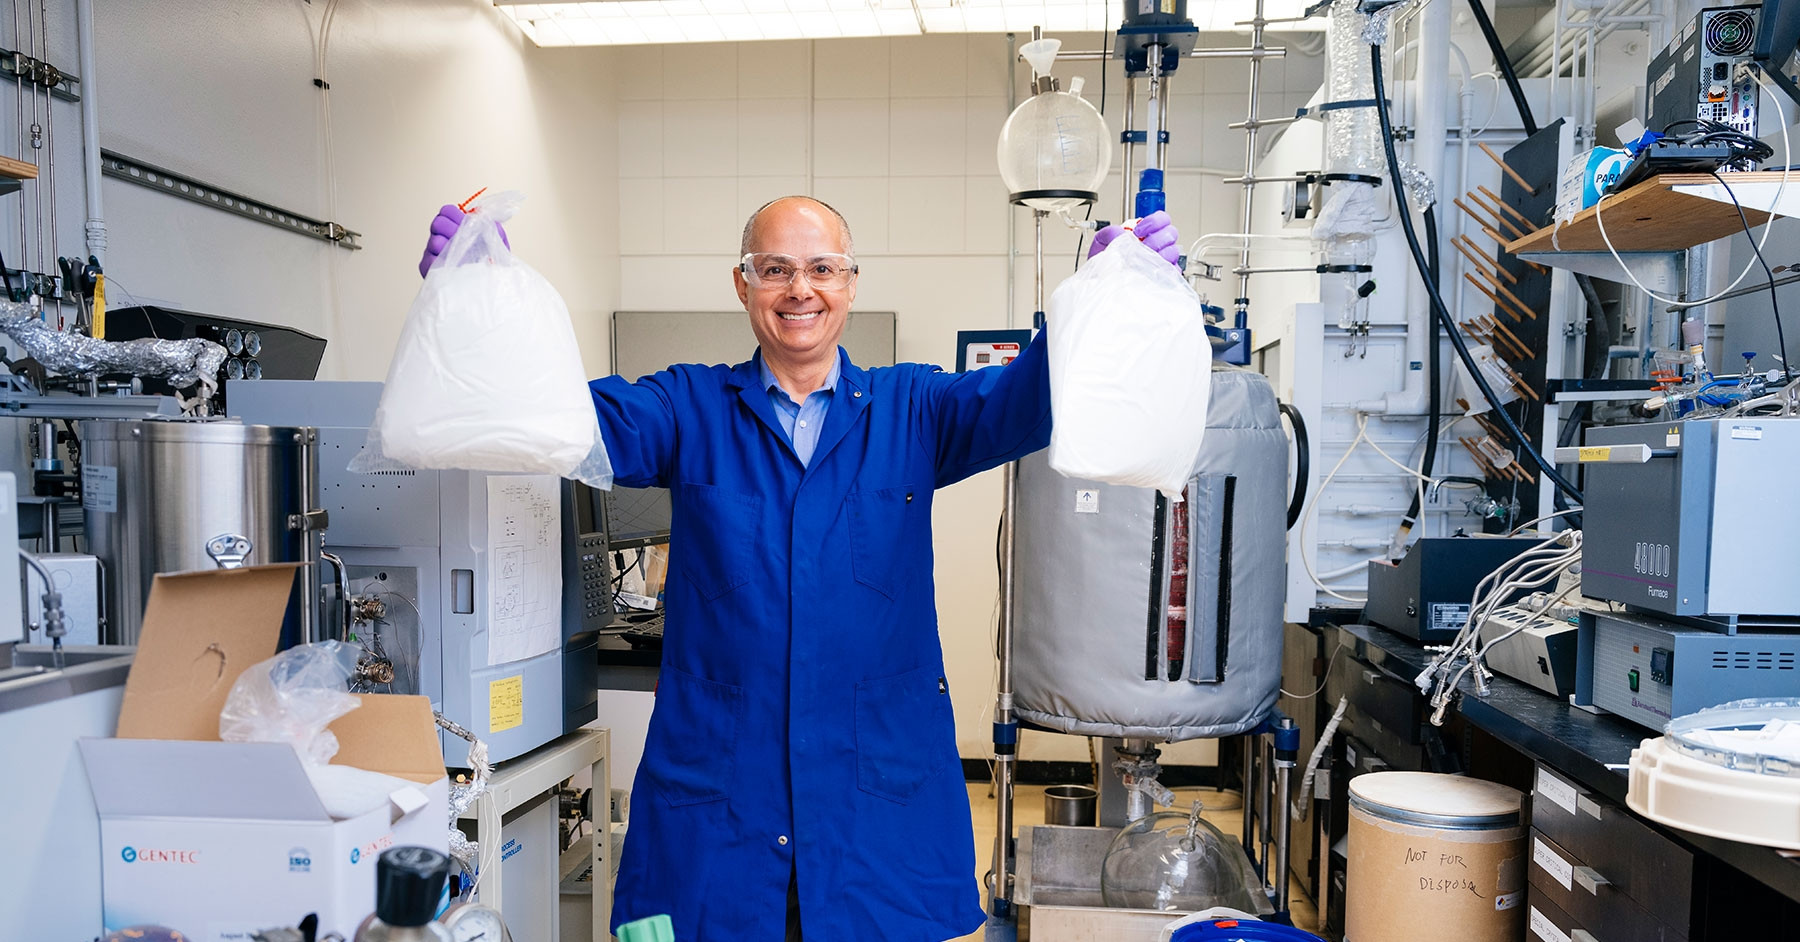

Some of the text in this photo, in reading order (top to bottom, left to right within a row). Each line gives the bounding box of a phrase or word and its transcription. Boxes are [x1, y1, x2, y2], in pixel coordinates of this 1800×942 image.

[1634, 542, 1670, 577] 48000
[1648, 585, 1668, 599] Furnace
[138, 849, 198, 864] GENTEC
[1405, 848, 1467, 868] NOT FOR
